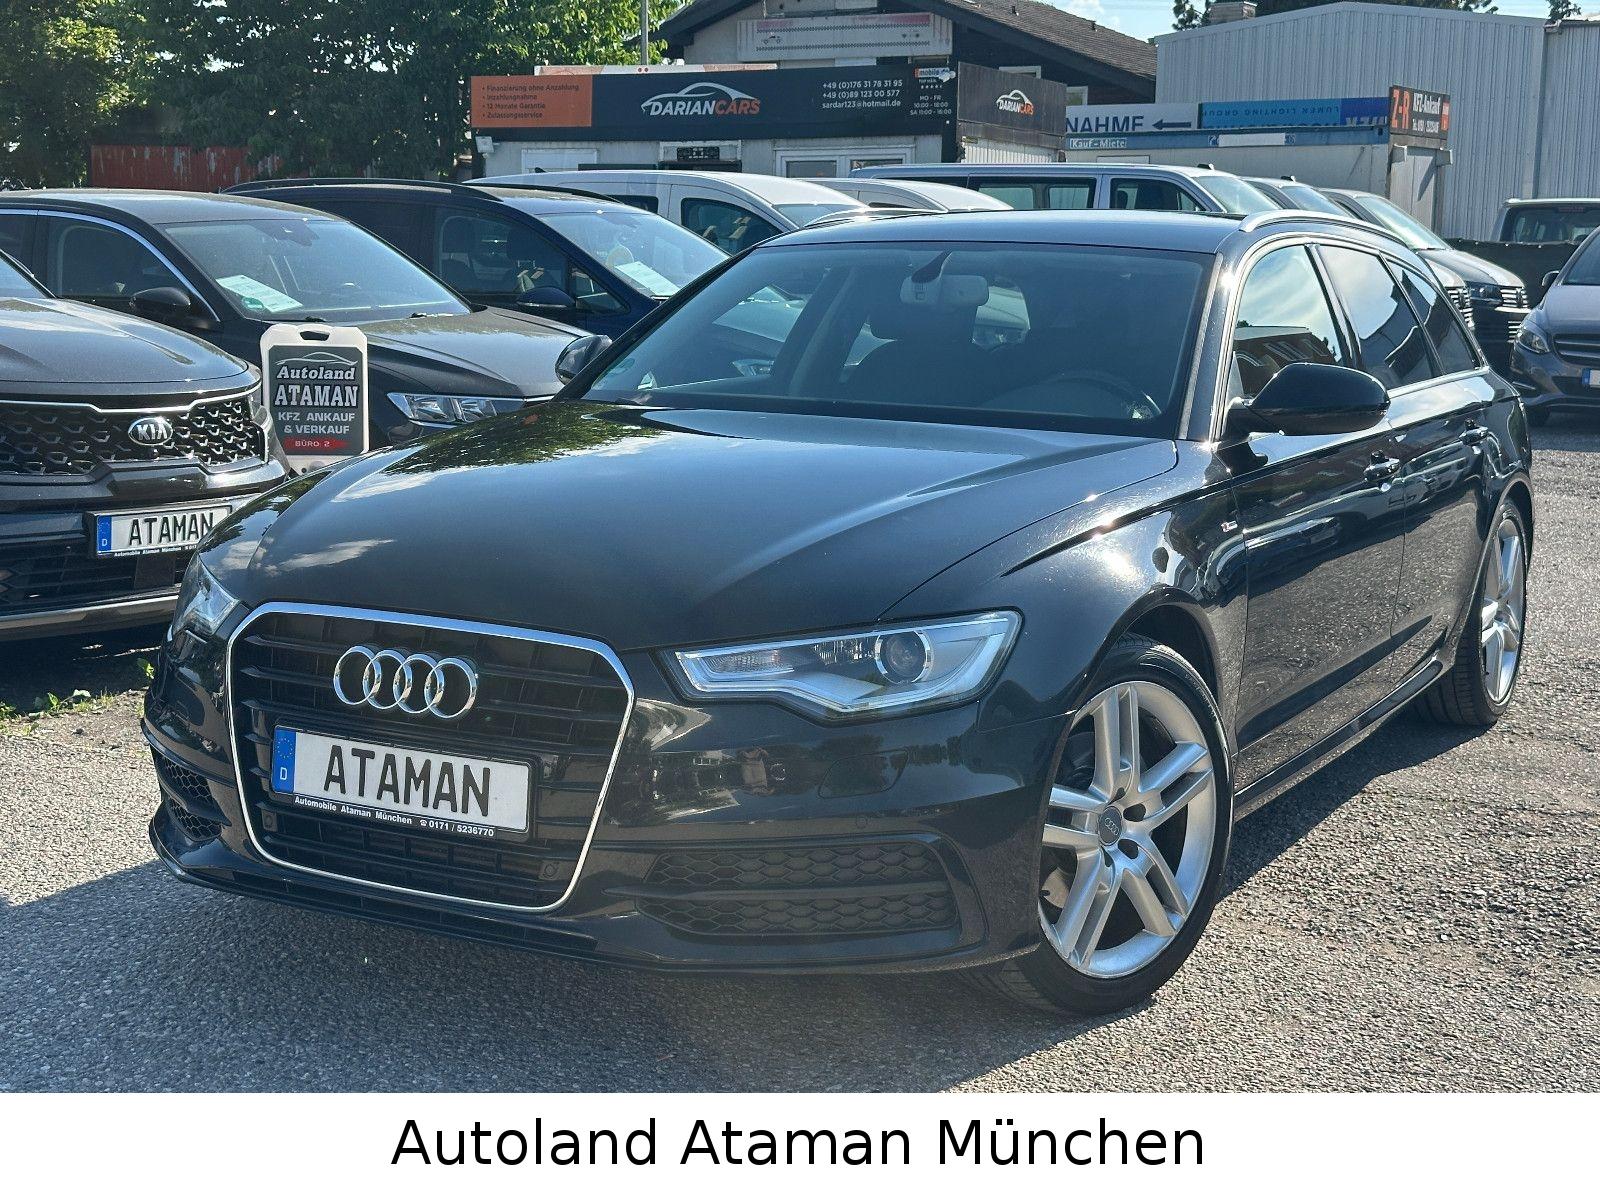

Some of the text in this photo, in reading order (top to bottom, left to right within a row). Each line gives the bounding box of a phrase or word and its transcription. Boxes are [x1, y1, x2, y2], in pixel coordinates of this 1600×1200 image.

[838, 81, 861, 89] (0)176
[838, 90, 858, 99] (0)89
[650, 99, 760, 116] DARIANCARS
[276, 366, 356, 380] Autoland
[275, 384, 358, 407] ATAMAN
[278, 412, 355, 422] KFZ ANKAUF
[136, 423, 168, 440] KIA
[284, 425, 350, 434] & VERKAUF
[129, 512, 214, 546] ATAMAN
[280, 767, 287, 781] D
[324, 744, 491, 817] ATAMAN
[294, 796, 336, 812] Automobile
[341, 805, 371, 818] Ataman
[375, 810, 412, 825] München
[429, 820, 449, 831] 0171
[457, 824, 494, 837] 5236770
